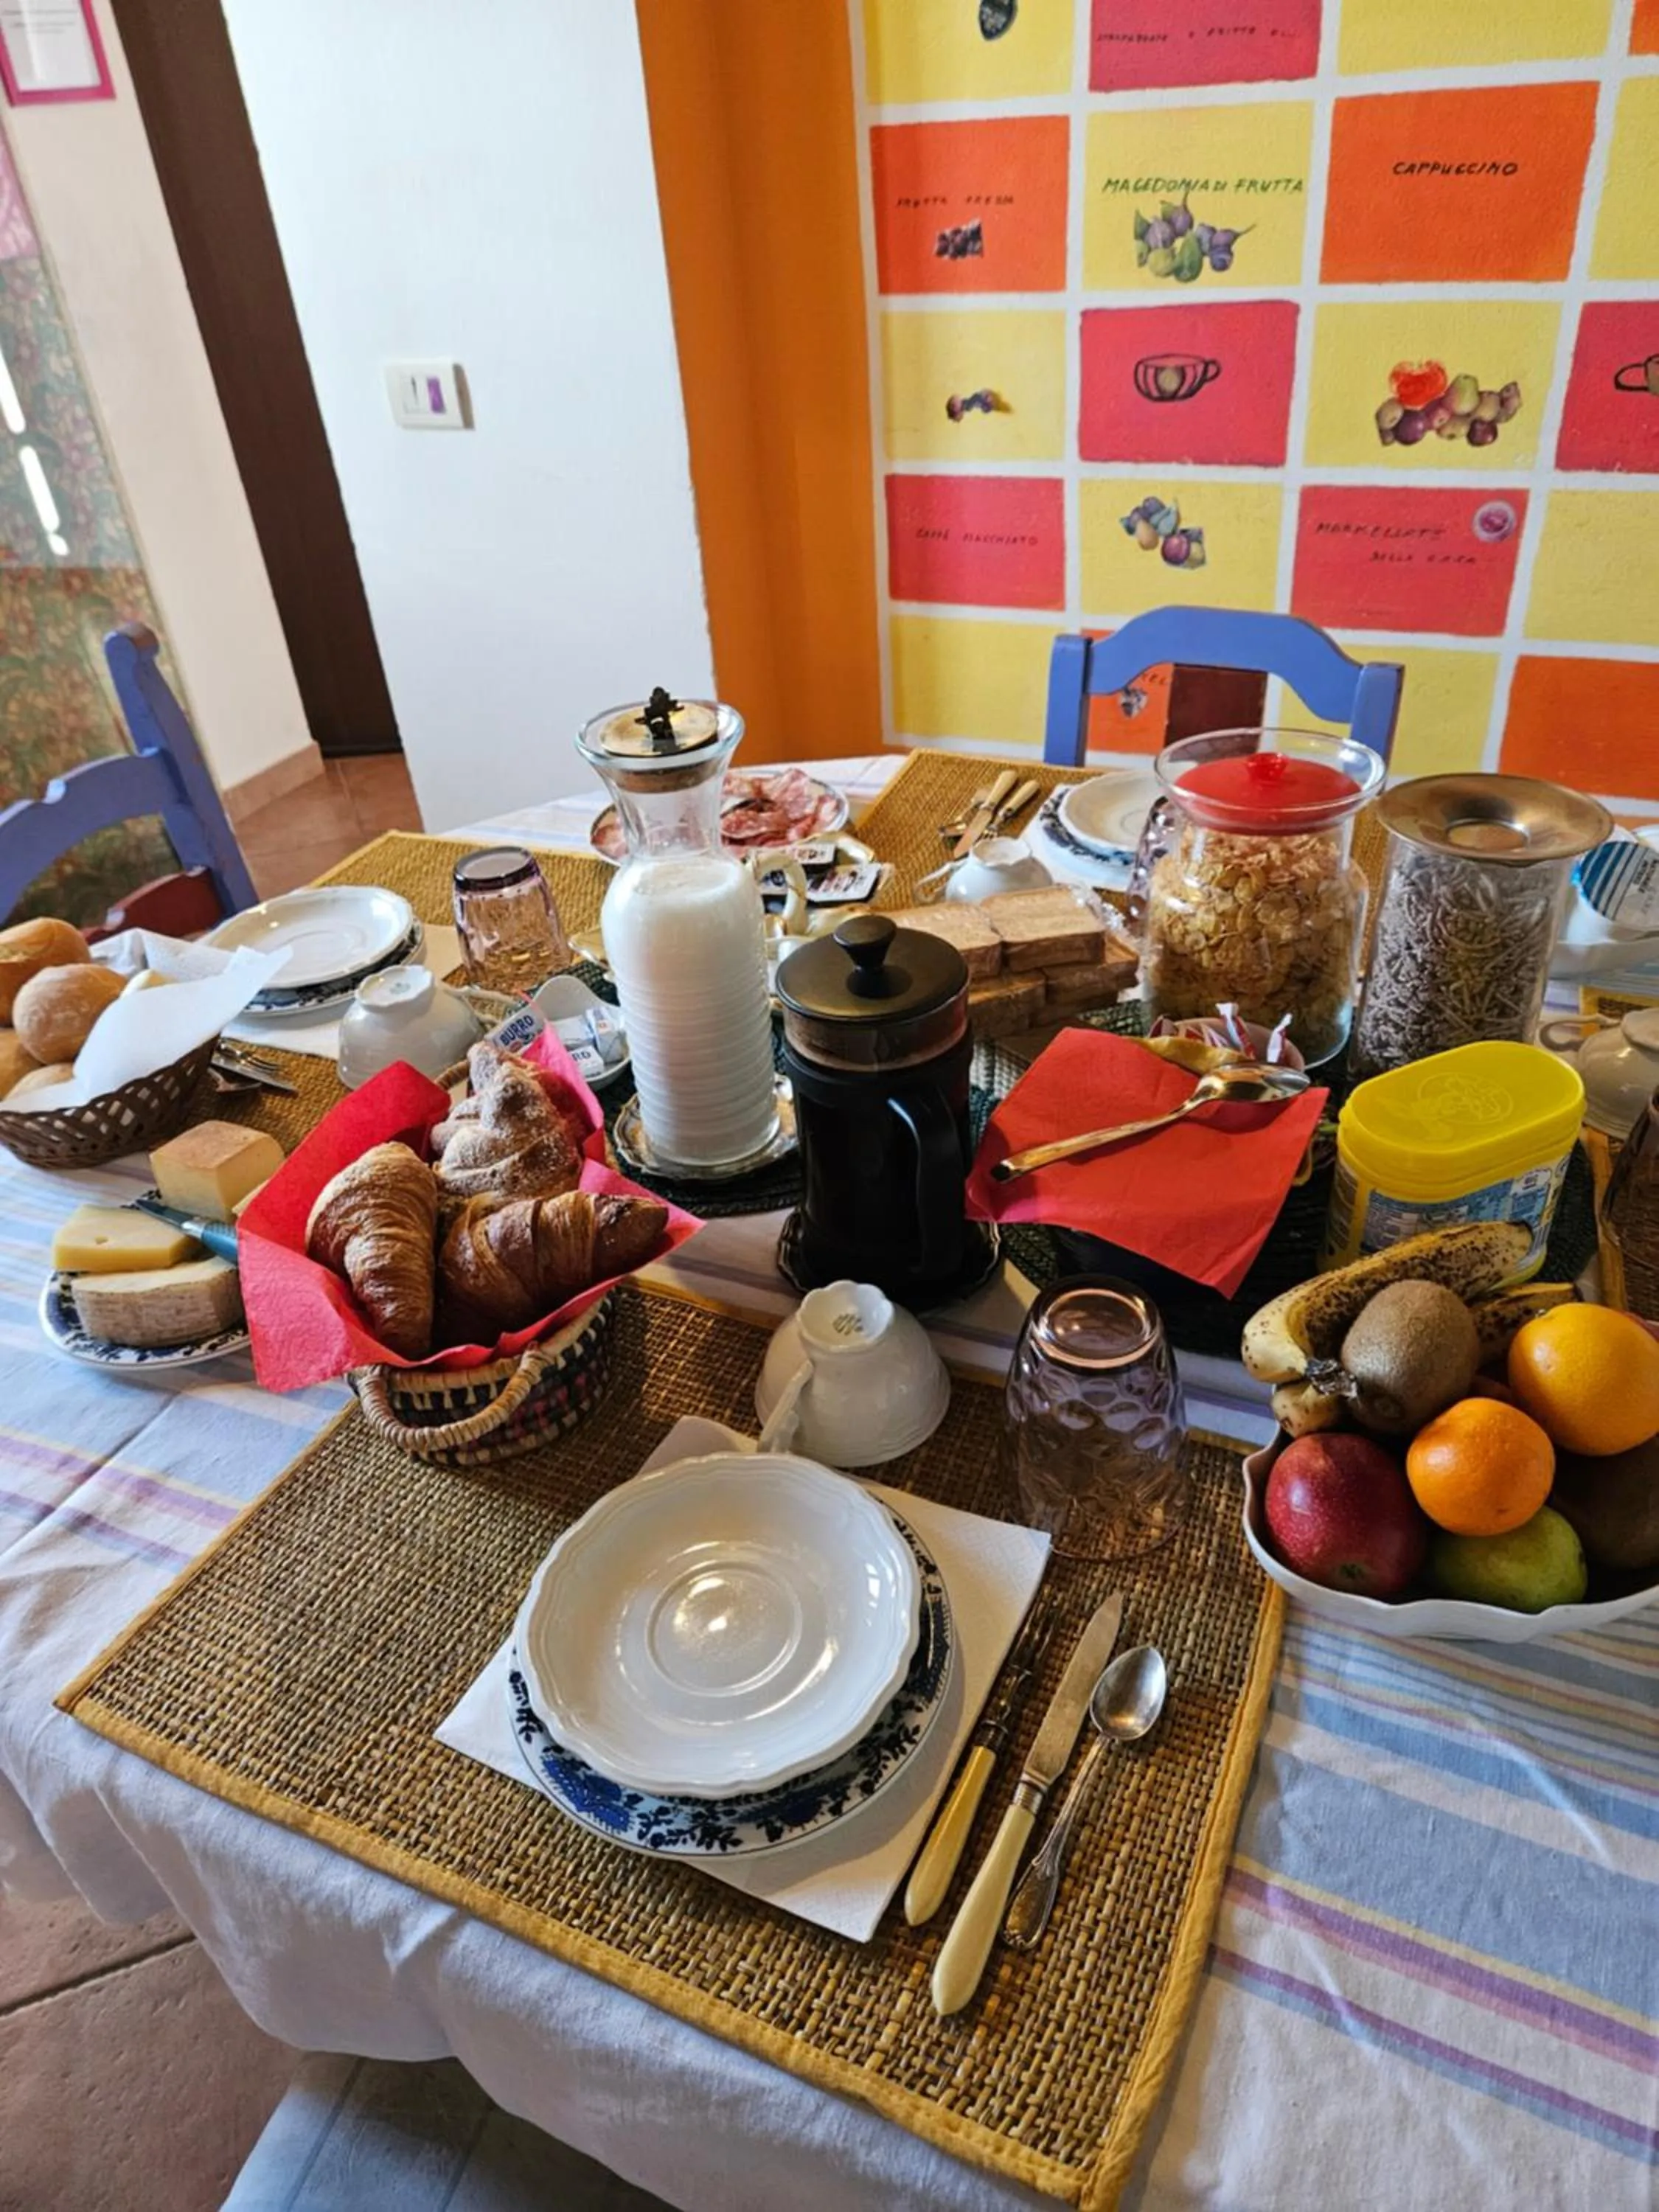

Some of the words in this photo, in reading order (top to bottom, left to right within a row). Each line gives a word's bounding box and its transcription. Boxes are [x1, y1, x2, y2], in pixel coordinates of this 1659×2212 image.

[1393, 161, 1518, 176] CAPPUCCINO
[1102, 178, 1209, 193] MACEDONIA
[1235, 178, 1304, 192] FRUTTA
[500, 1015, 534, 1046] BURRO
